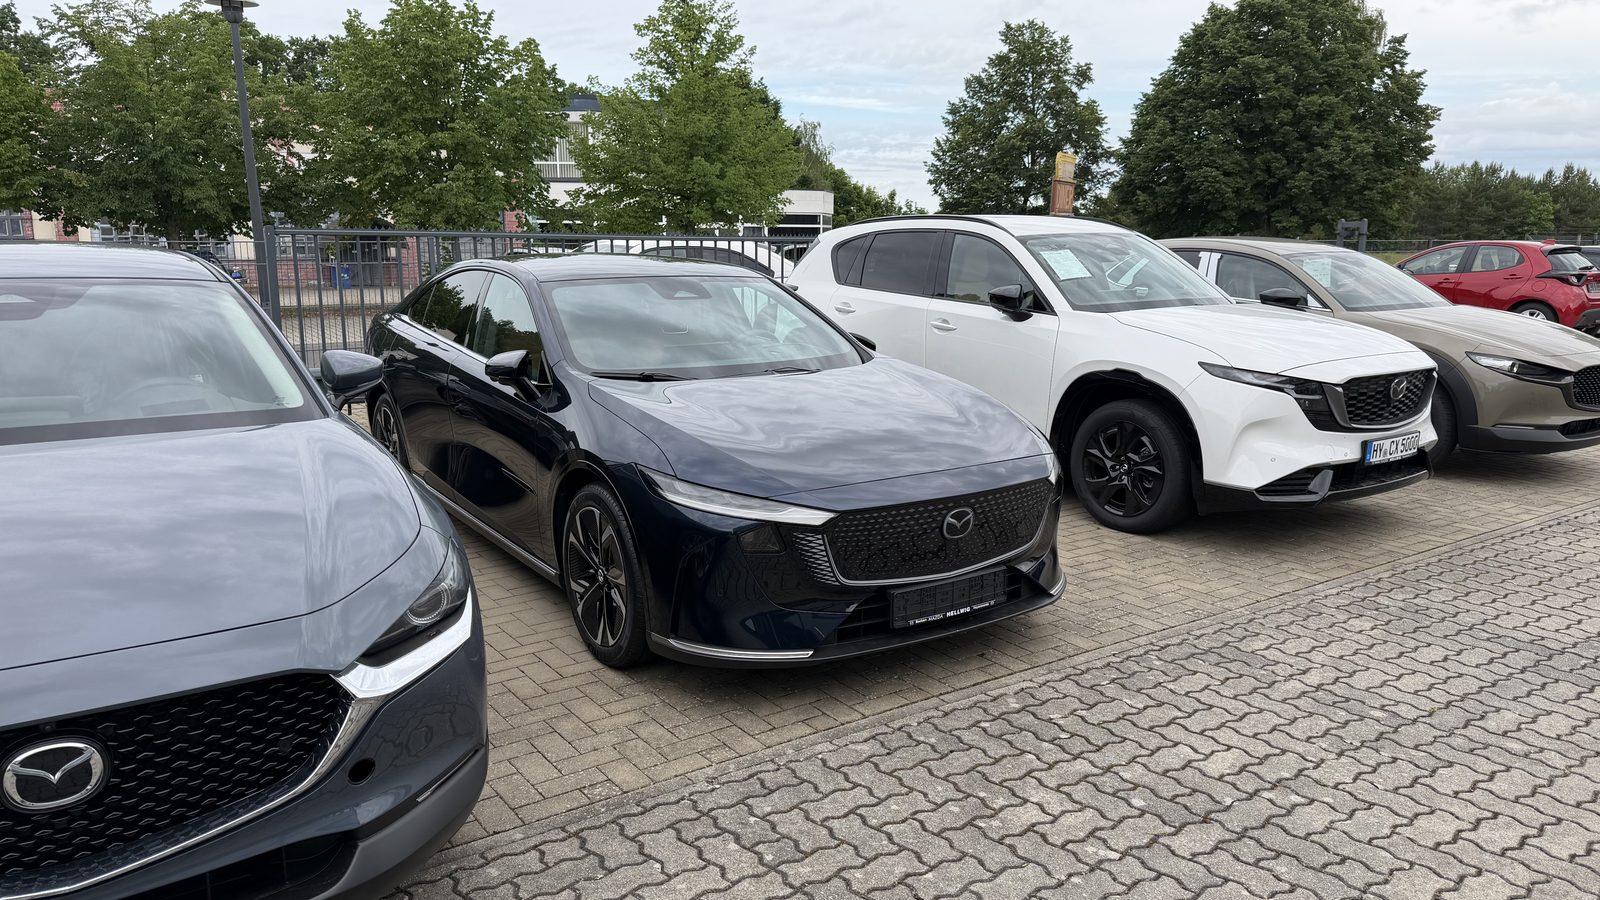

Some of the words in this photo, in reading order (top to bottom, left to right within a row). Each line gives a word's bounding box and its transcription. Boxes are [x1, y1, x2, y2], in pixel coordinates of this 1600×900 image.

[1372, 442, 1384, 459] HY
[1389, 440, 1401, 456] CX
[1401, 435, 1418, 453] 5000
[946, 606, 971, 617] HELLWIG
